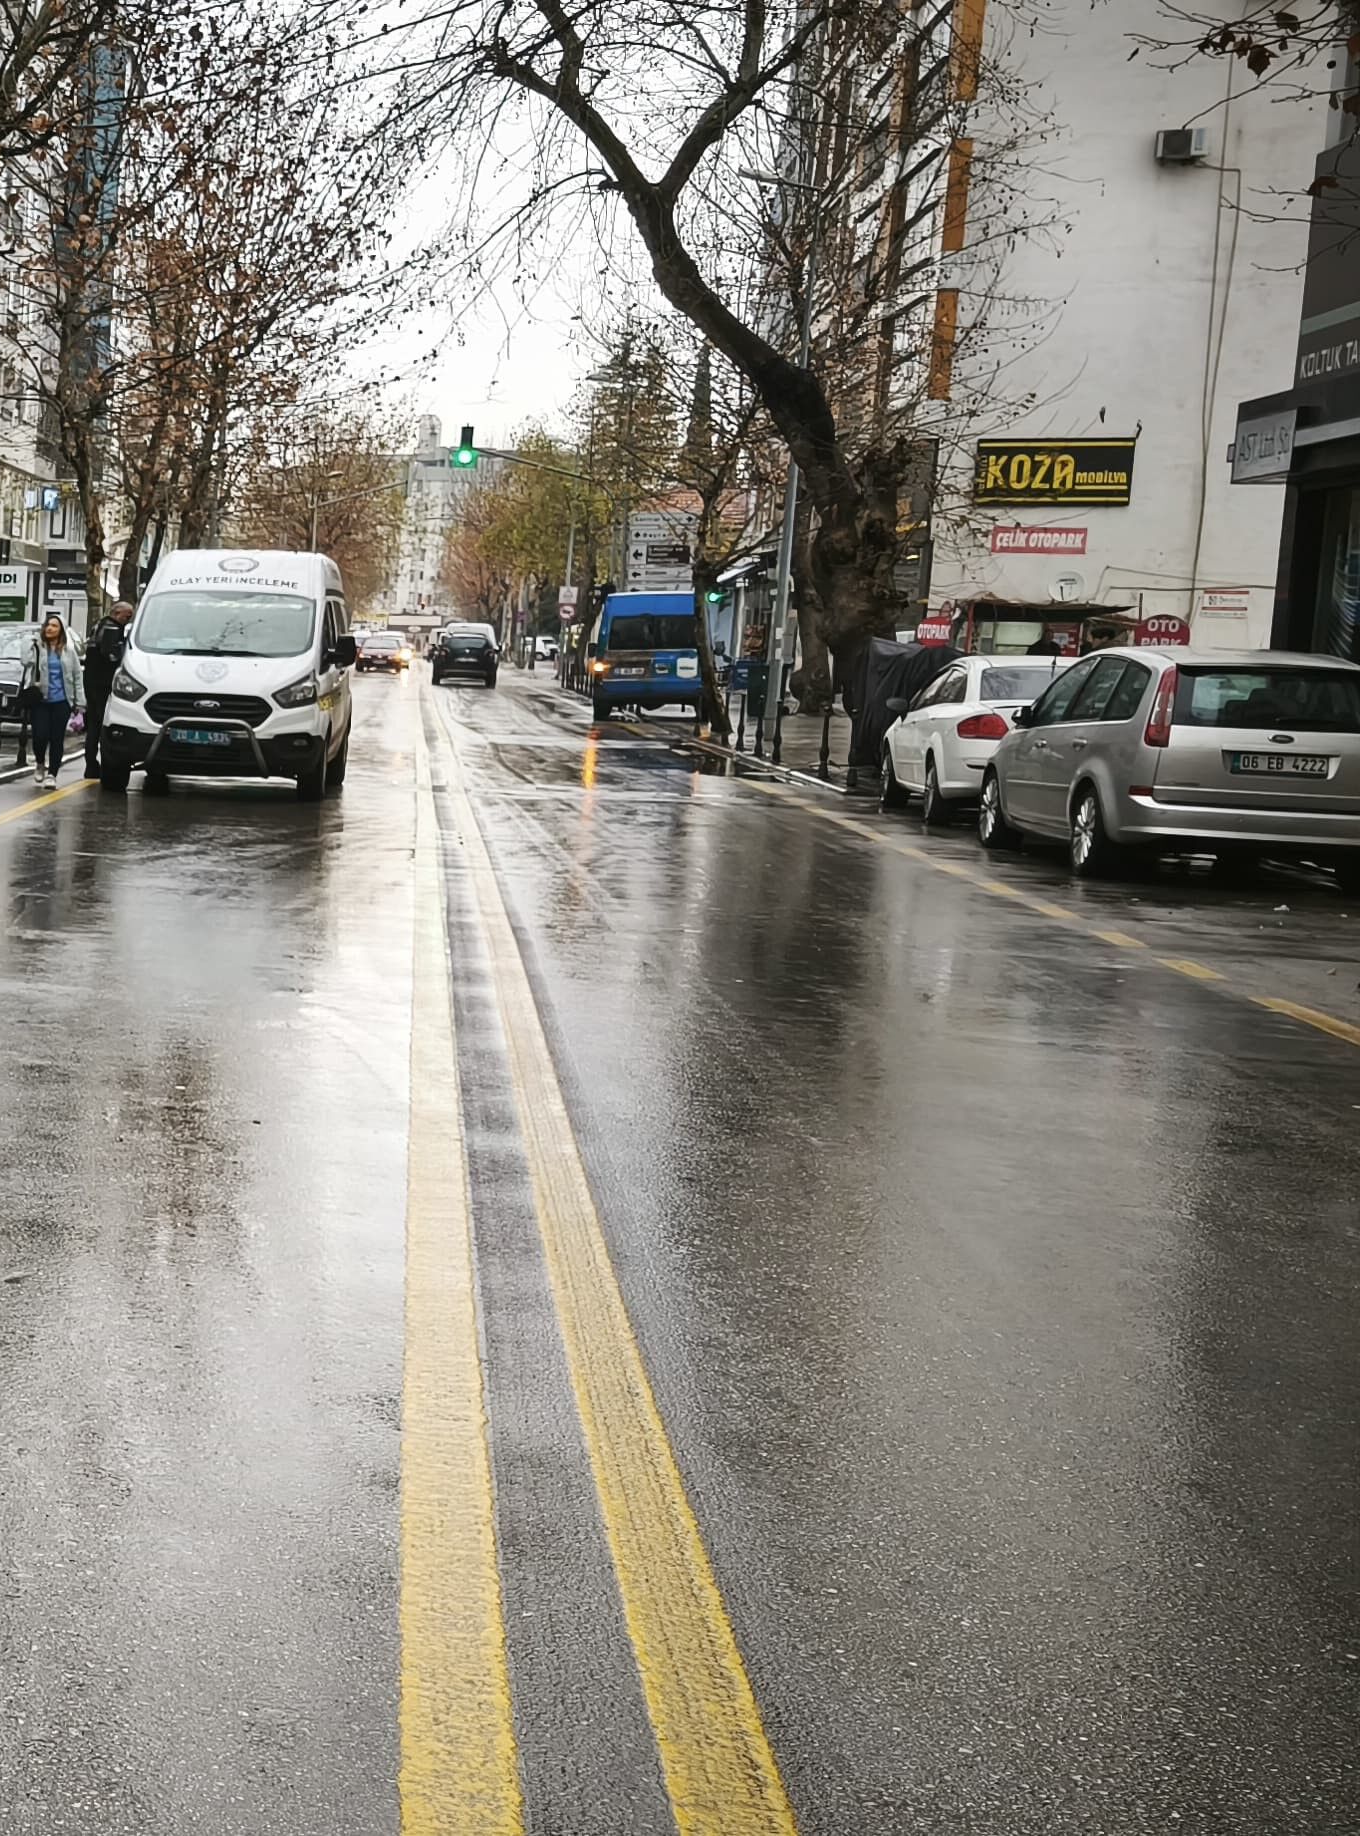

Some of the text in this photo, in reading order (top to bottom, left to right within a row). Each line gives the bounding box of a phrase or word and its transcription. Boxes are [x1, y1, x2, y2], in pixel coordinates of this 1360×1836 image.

[986, 453, 1075, 490] KOZA
[1029, 532, 1085, 548] OTOPARK
[917, 624, 951, 641] OTOPARK
[1147, 619, 1180, 633] OTO
[1242, 755, 1326, 773] 06 EB 4222
